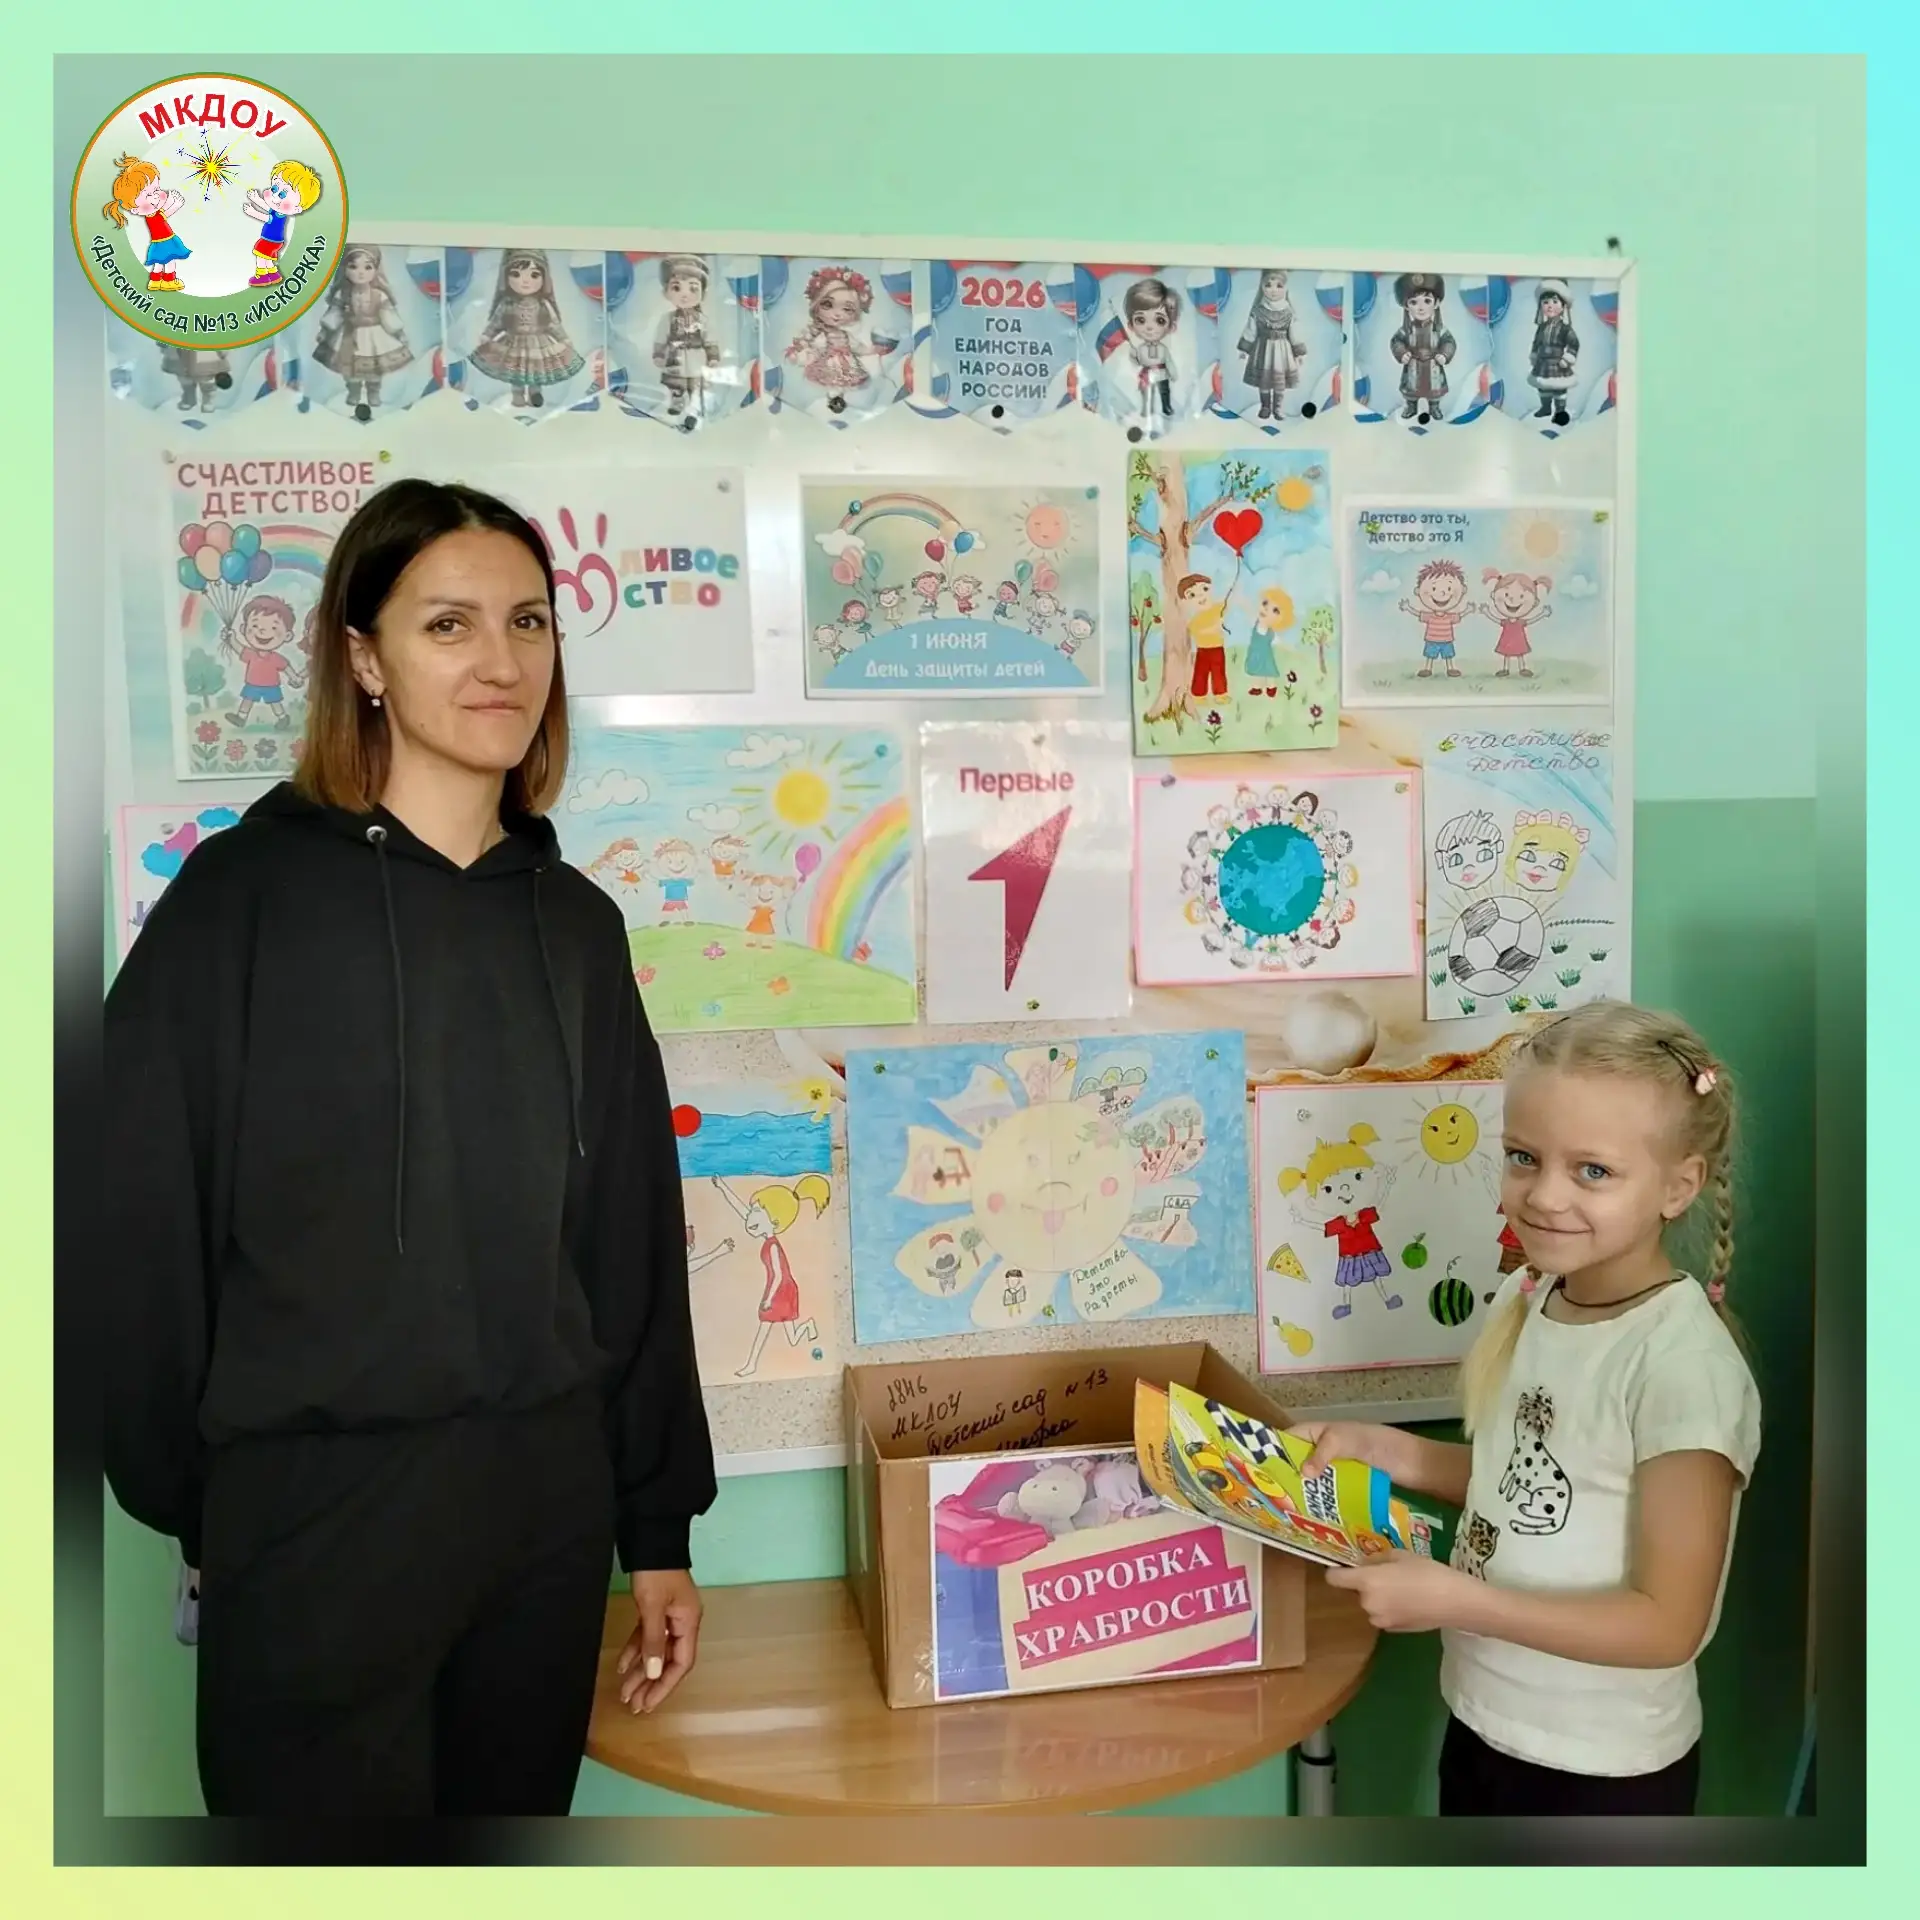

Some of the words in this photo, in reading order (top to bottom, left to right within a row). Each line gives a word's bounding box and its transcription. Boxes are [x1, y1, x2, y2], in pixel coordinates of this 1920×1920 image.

[961, 277, 1046, 308] 2026
[985, 318, 1022, 333] ГОД
[955, 338, 1053, 356] ЕДИНСТВА
[959, 360, 1049, 378] НАРОДОВ
[962, 382, 1047, 399] РОССИИ!
[178, 461, 375, 488] СЧАСТЛИВОЕ
[202, 489, 361, 519] ДЕТСТВО!
[1358, 511, 1417, 525] Детство
[1420, 513, 1443, 524] это
[1447, 513, 1470, 526] ты,
[1428, 532, 1451, 543] это
[1454, 530, 1464, 542] Я
[910, 634, 918, 649] 1
[926, 632, 988, 649] ИЮНЯ
[864, 660, 908, 678] День
[915, 663, 987, 680] защиты
[995, 660, 1045, 677] детей
[959, 767, 1075, 800] Первые
[1012, 1388, 1047, 1416] сад
[1085, 1368, 1108, 1390] 13
[1303, 1478, 1326, 1521] ОНКИ
[1026, 1543, 1213, 1611] КОРОБКА
[1016, 1578, 1249, 1662] ХРАБРОСТИ
